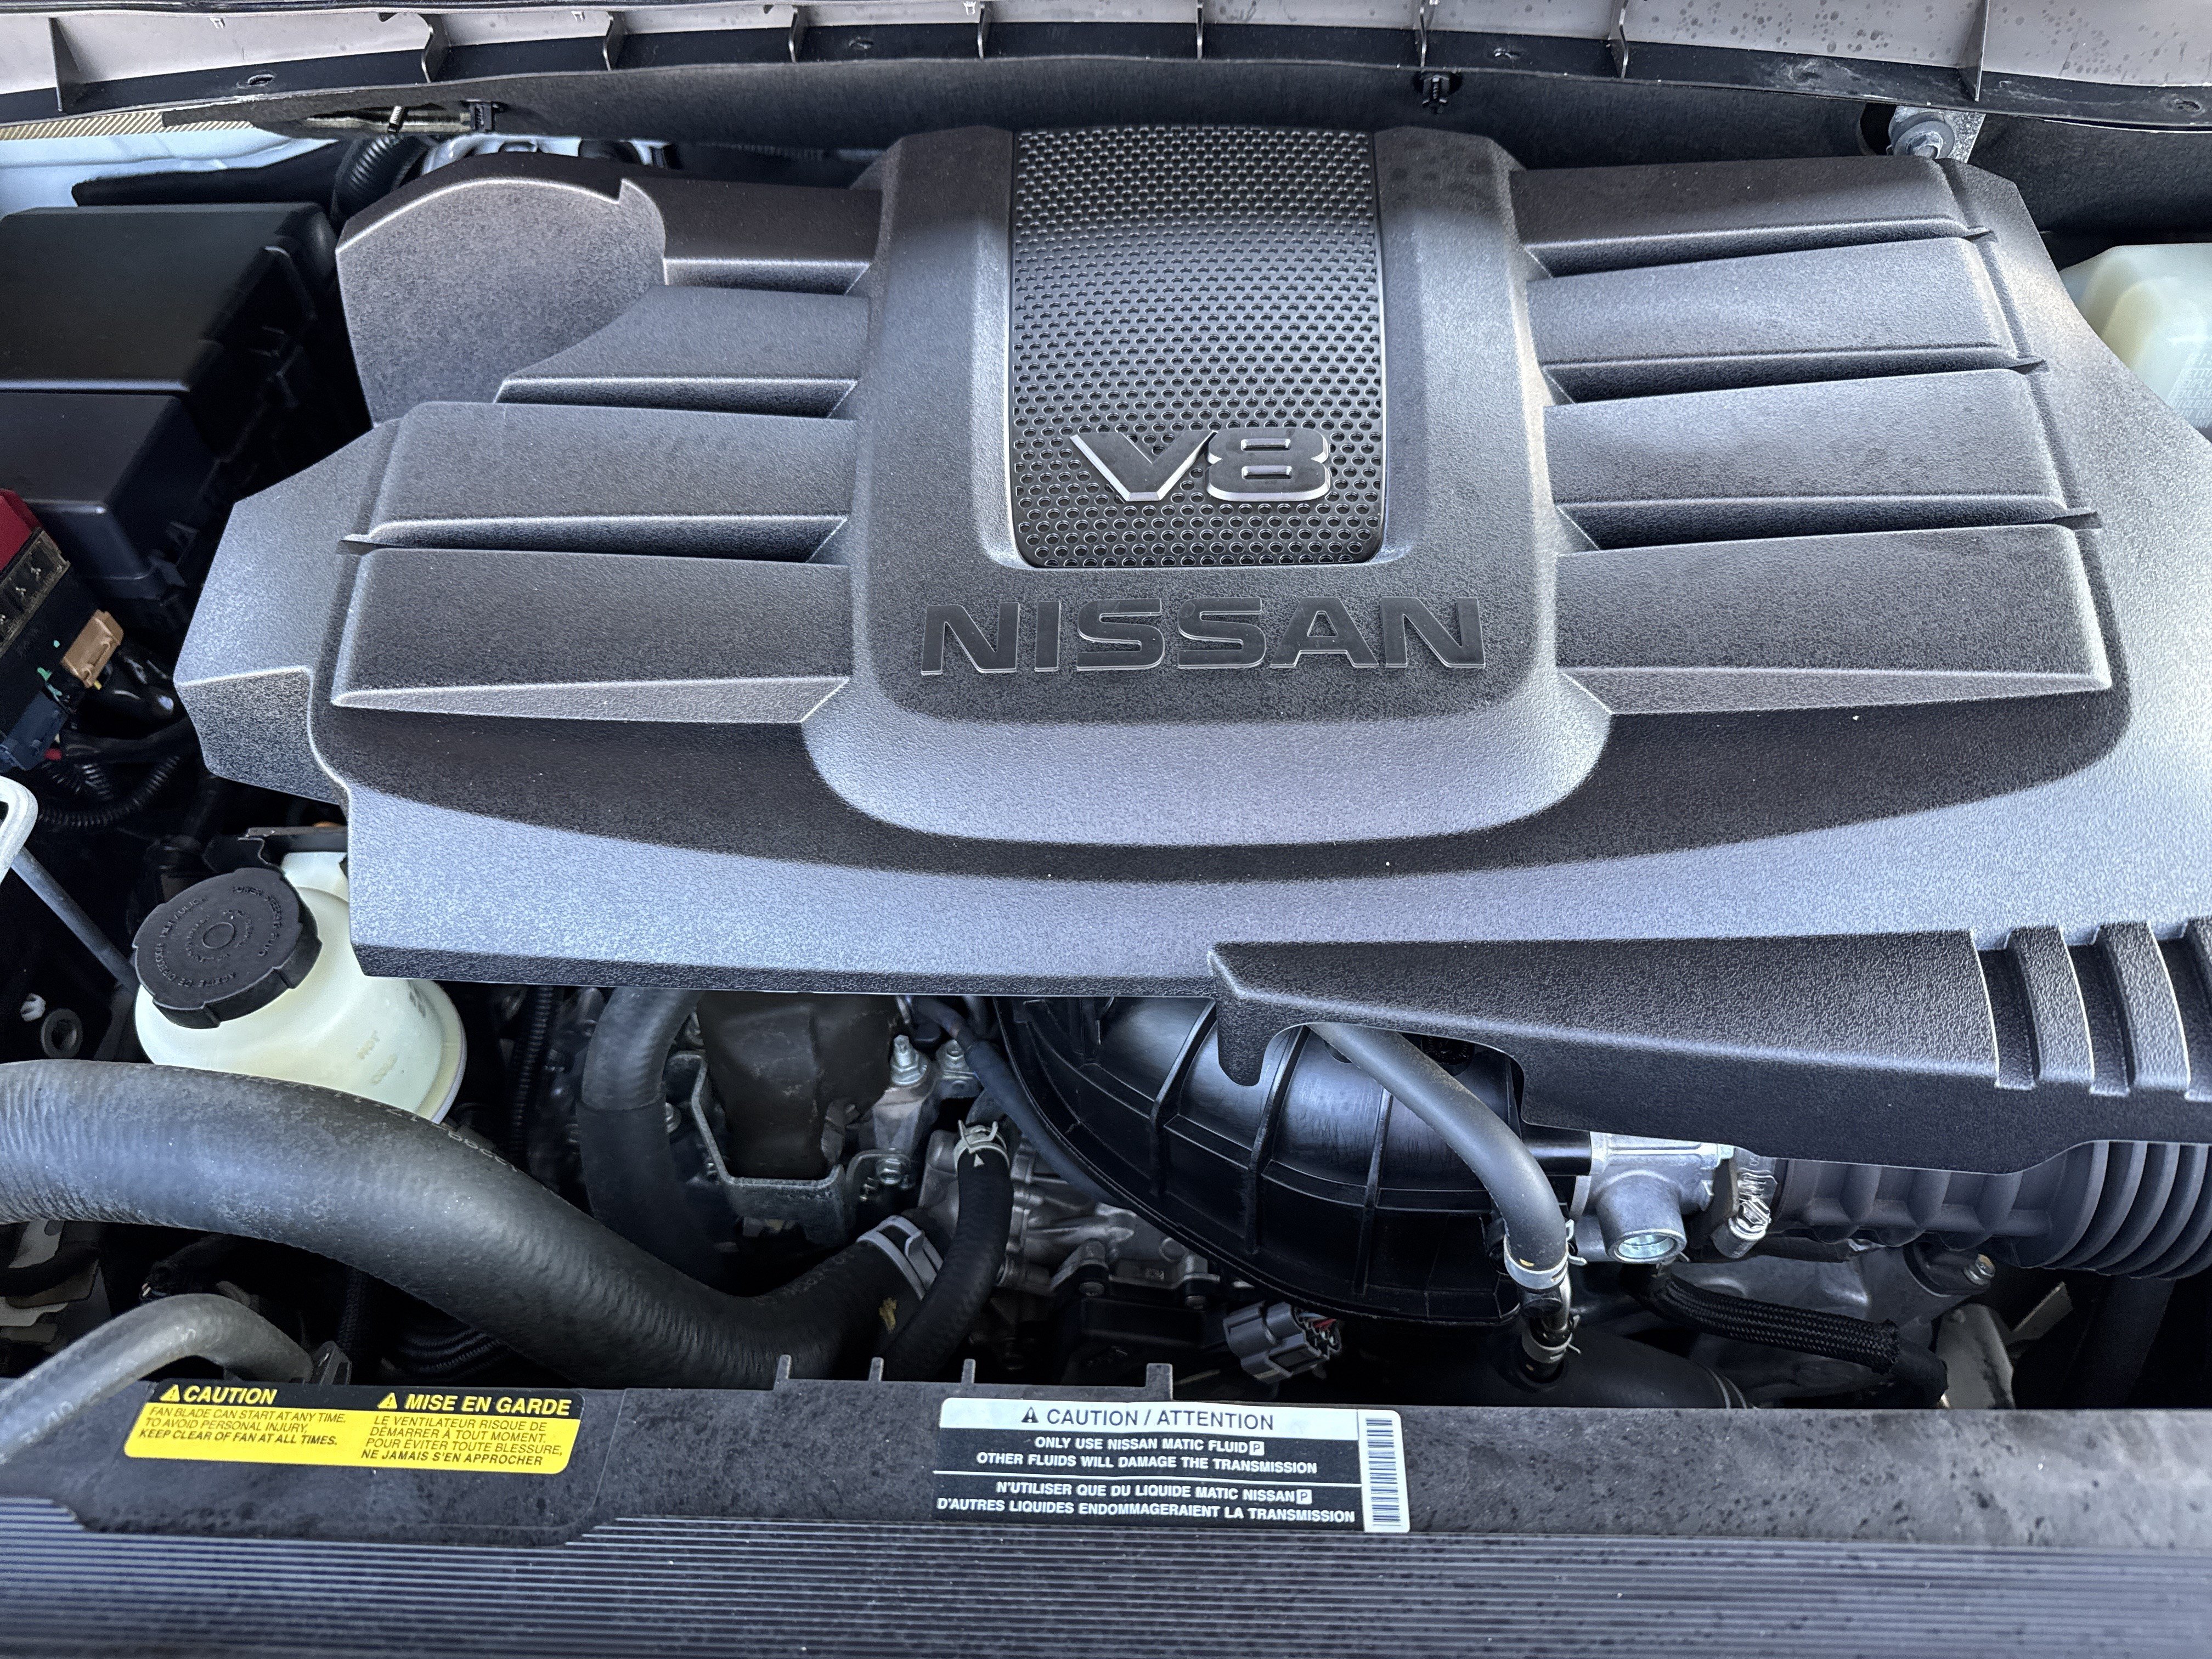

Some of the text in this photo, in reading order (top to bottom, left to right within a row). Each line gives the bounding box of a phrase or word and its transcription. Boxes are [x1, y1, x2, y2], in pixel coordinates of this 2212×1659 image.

[1069, 427, 1331, 503] V8
[920, 596, 1486, 675] NISSAN
[178, 978, 193, 988] DE
[184, 1385, 278, 1405] CAUTION
[404, 1393, 572, 1416] MISE EN GARDE
[149, 1407, 346, 1423] FAN BLADE CAN START AT ANY TIME.
[374, 1415, 548, 1431] LE VENTILATEUR RISQUE DE
[1047, 1408, 1274, 1430] CAUTION / ATTENTION
[146, 1417, 308, 1434] TO AVOID PERSONAL INJURY,
[370, 1424, 546, 1443] DÉMARRER À TOUT MOMENT.
[138, 1429, 337, 1446] KEEP CLEAR OF FAN AT ALL TIMES.
[365, 1437, 562, 1456] POUR ÉVITER TOUTE BLESSURE,
[1034, 1436, 1071, 1448] ONLY
[1075, 1438, 1103, 1449] USE
[1107, 1438, 1158, 1450] NISSAN
[1161, 1439, 1204, 1451] MATIC
[1209, 1440, 1248, 1453] FLUID
[361, 1449, 543, 1466] NE JAMAIS S'EN APPROCHER
[976, 1452, 1317, 1474] OTHER FLUIDS WILL DAMAGE THE TRANSMISSION
[996, 1481, 1072, 1495] N'UTILISER
[1076, 1484, 1107, 1497] QUE
[1110, 1485, 1131, 1497] DU
[1135, 1485, 1191, 1498] LIQUIDE
[1195, 1486, 1239, 1499] MATIC
[1243, 1489, 1295, 1502] NISSAN
[937, 1498, 1355, 1522] D'AUTRES LIQUIDES ENDOMMAGERAIENT LA TRANSMISSION
